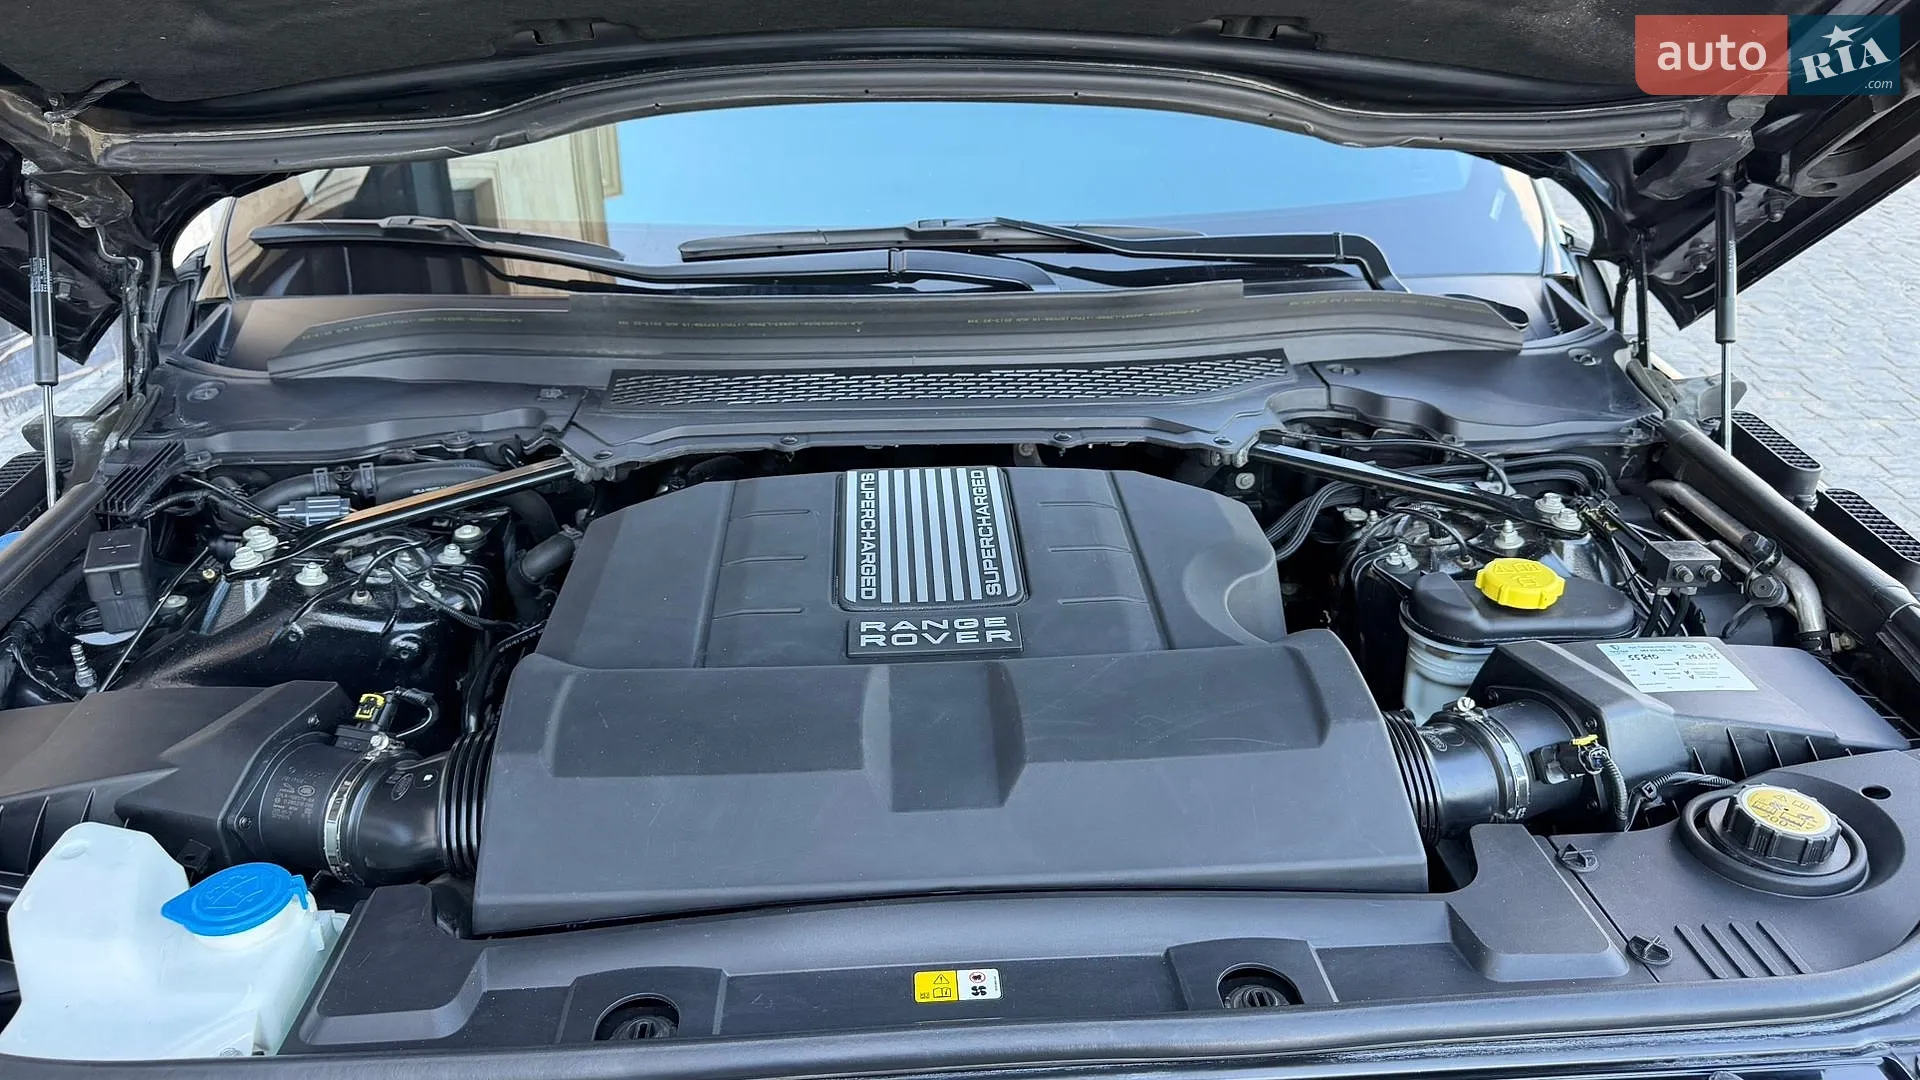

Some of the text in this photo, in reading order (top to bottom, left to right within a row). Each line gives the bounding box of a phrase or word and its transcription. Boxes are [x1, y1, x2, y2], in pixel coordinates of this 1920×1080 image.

[860, 472, 877, 600] SUPERCHARGED
[970, 470, 1002, 596] SUPERCHARGED
[860, 616, 1008, 632] RANGE
[860, 629, 1013, 647] ROVER
